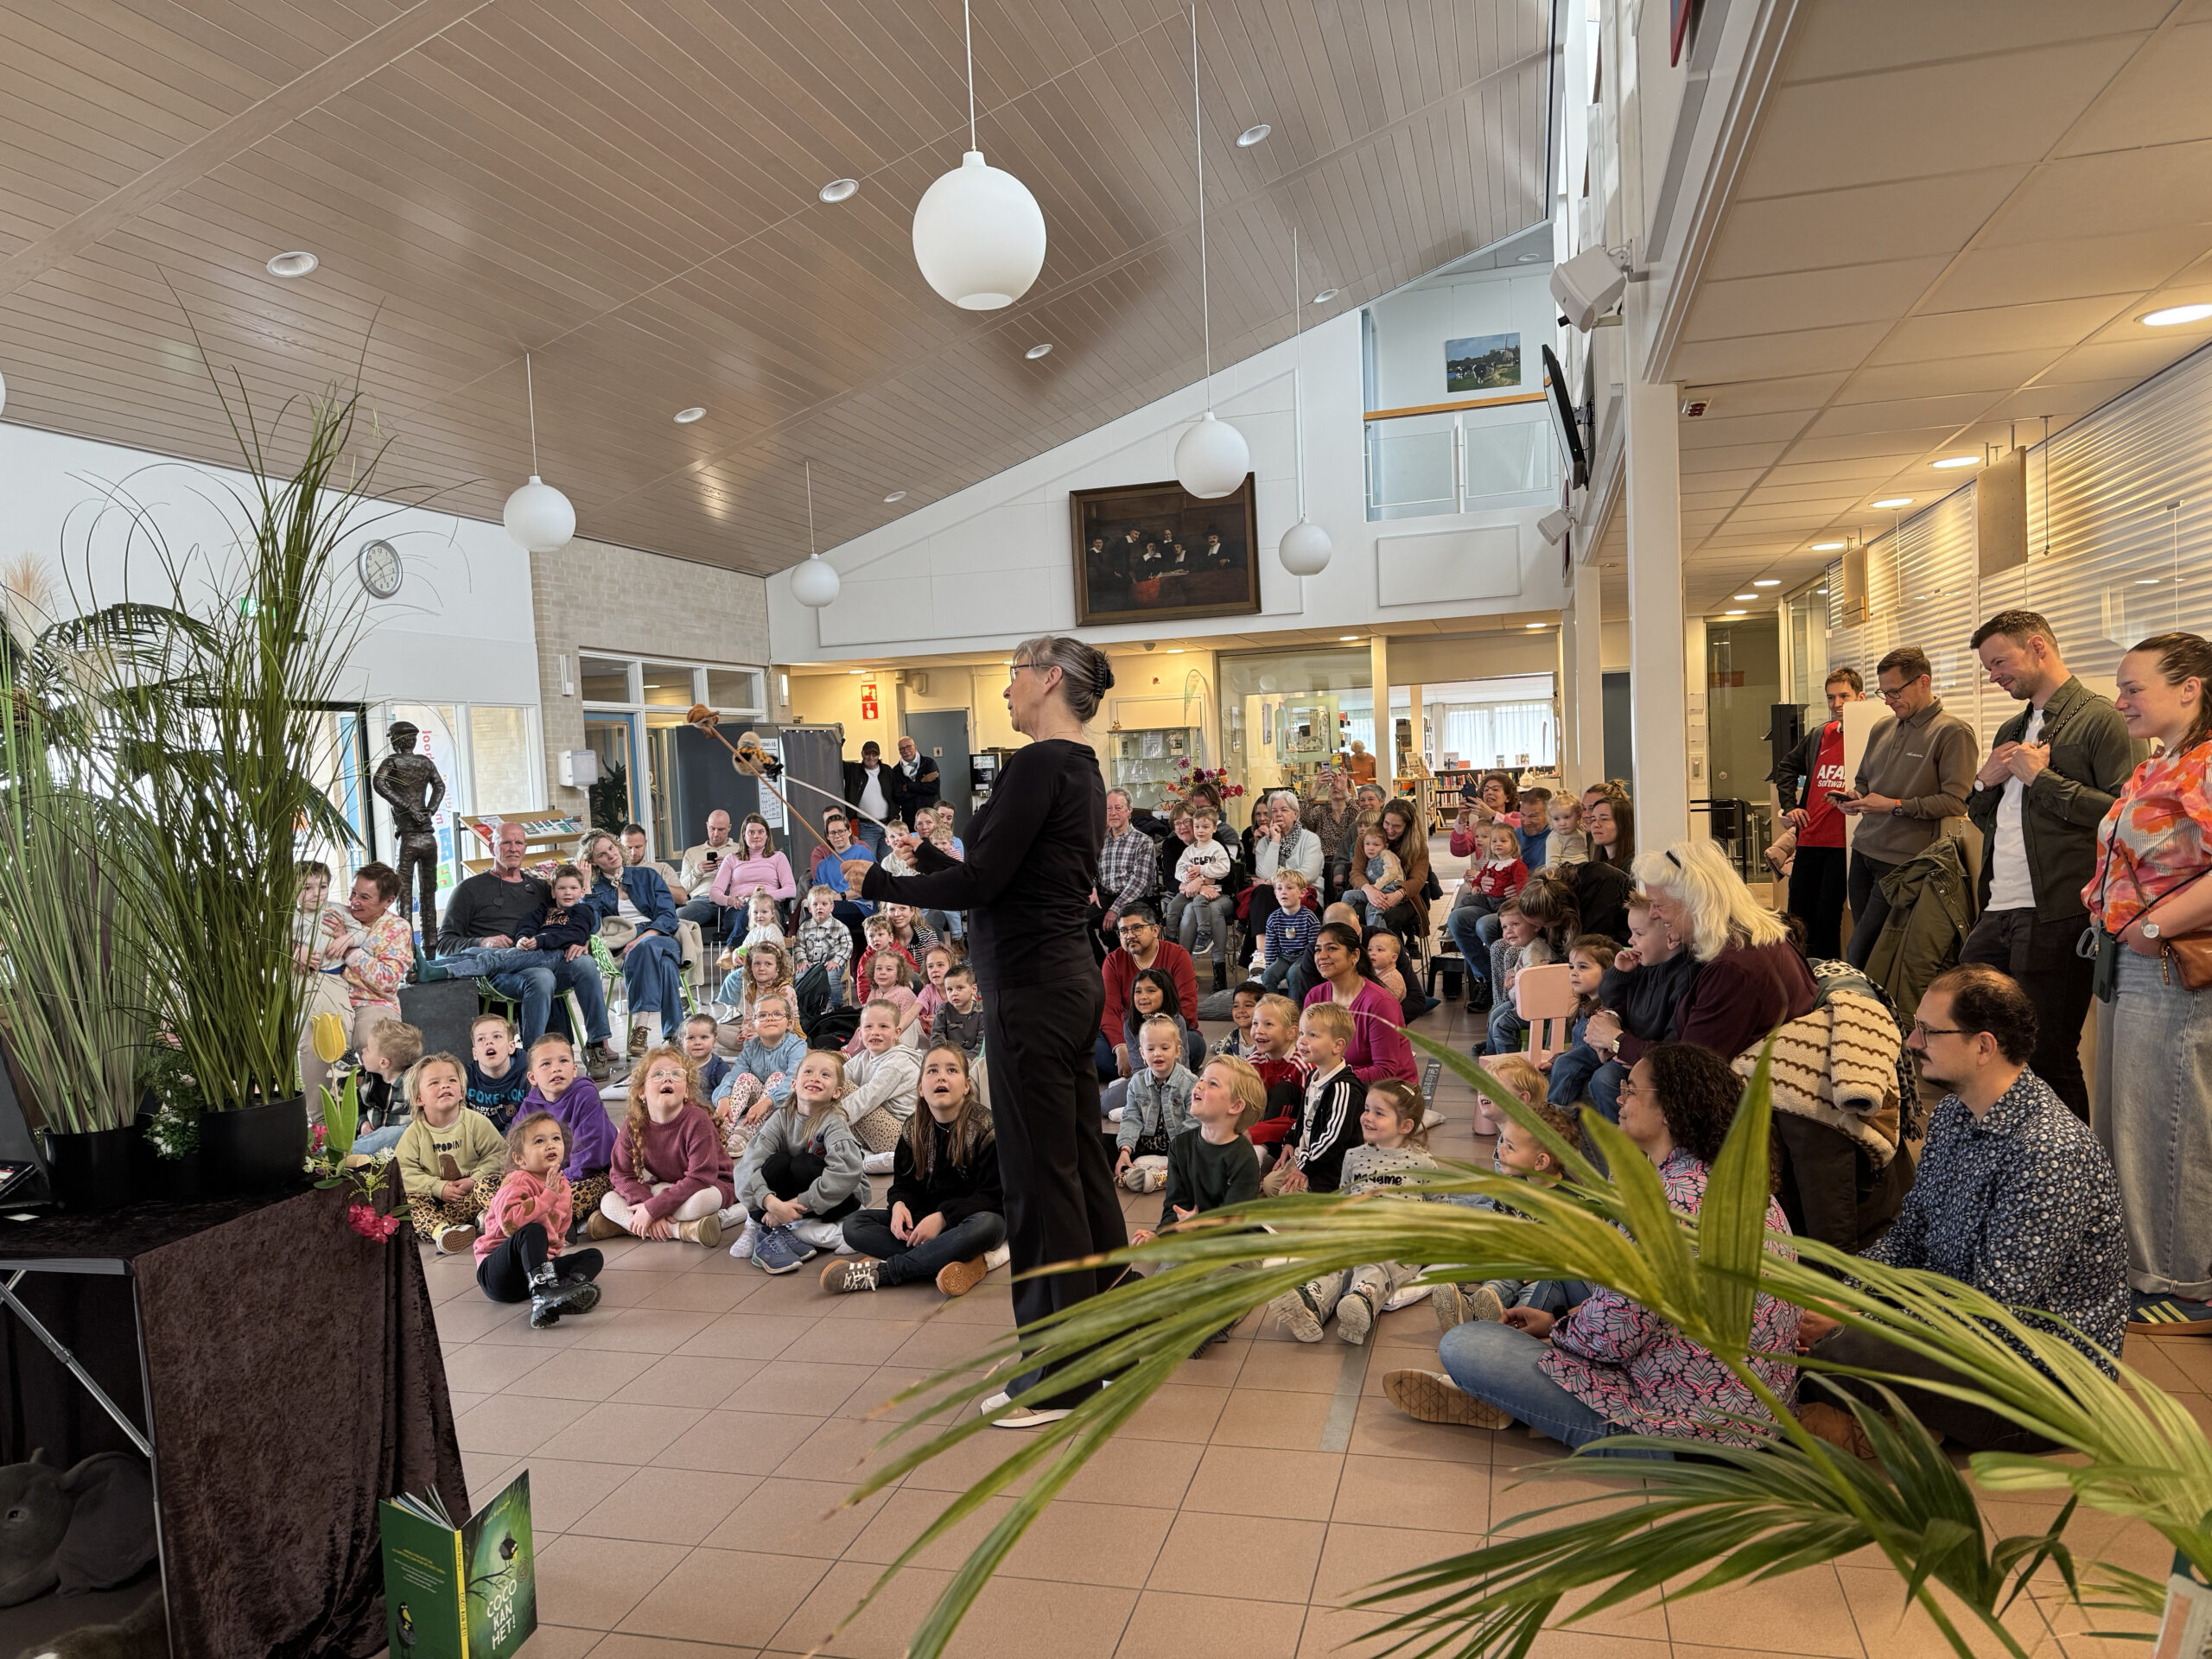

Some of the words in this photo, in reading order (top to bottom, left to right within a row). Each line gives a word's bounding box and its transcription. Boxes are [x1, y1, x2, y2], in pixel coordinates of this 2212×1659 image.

[1817, 765, 1845, 779] AFA
[1818, 779, 1846, 788] softwar
[486, 1579, 517, 1618] COCO
[493, 1599, 513, 1631] KAN
[492, 1614, 516, 1650] HET!
